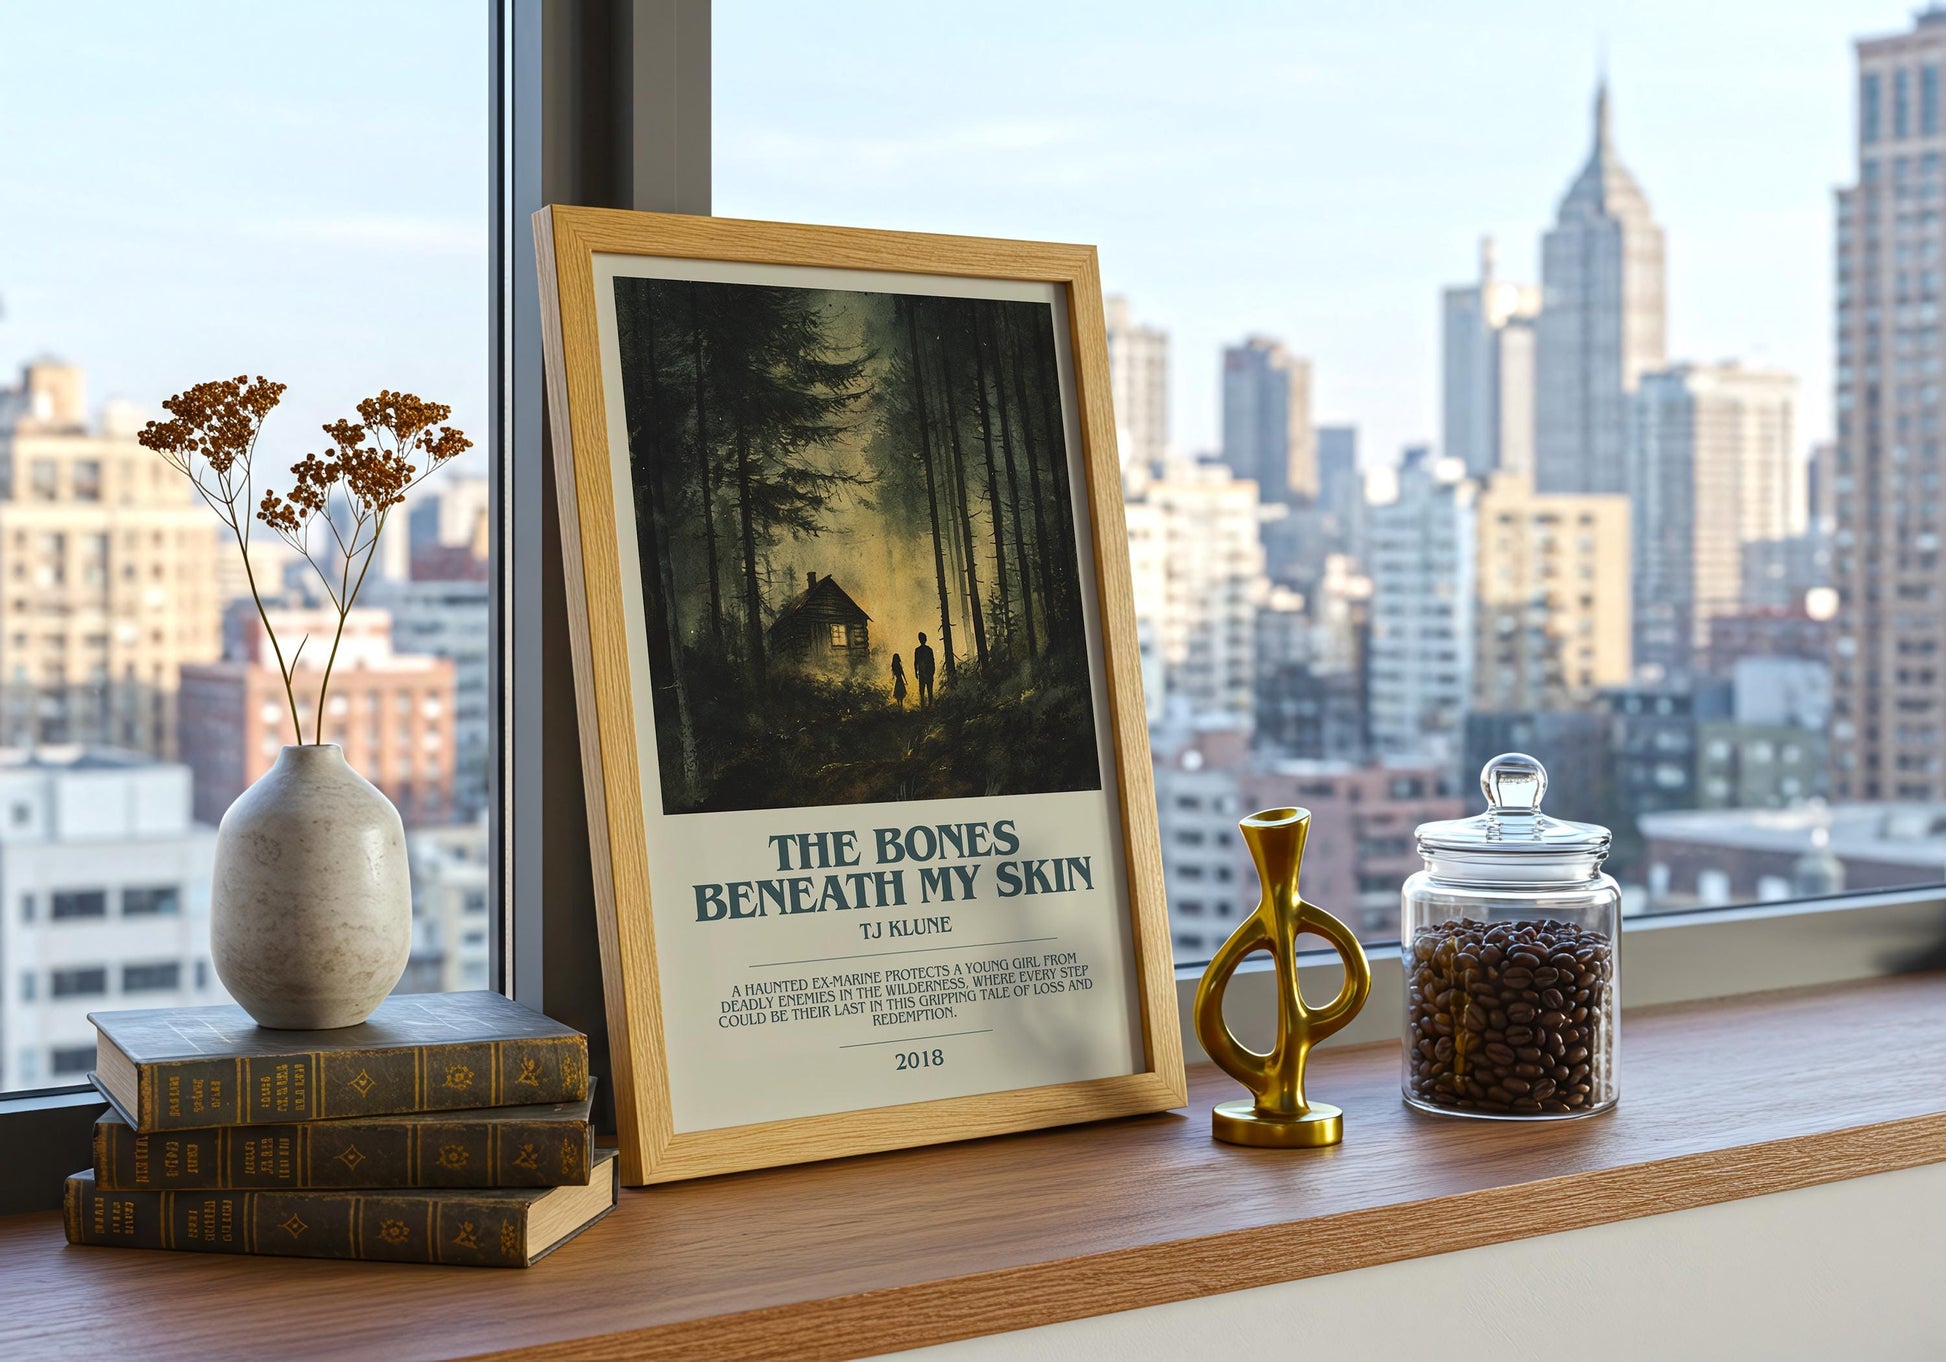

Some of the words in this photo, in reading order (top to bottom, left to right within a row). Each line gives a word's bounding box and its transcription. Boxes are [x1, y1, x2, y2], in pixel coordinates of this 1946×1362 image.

[769, 830, 861, 871] THE
[873, 820, 1019, 864] BONES
[692, 870, 907, 922] BENEATH
[918, 864, 981, 903] MY
[996, 856, 1094, 898] SKIN
[860, 922, 881, 939] TJ
[889, 916, 952, 937] KLUNE
[721, 997, 773, 1013] DEADLY
[778, 990, 835, 1007] ENEMIES
[840, 989, 852, 1001] IN
[856, 986, 882, 999] THE
[886, 977, 968, 996] WILDERNESS,
[973, 972, 1016, 987] WHERE
[1019, 968, 1056, 982] EVERY
[1060, 965, 1088, 978] STEP
[732, 986, 741, 997] A
[745, 979, 808, 996] HAUNTED
[812, 972, 881, 989] EX-MARINE
[886, 965, 950, 982] PROTECTS
[954, 964, 962, 975] A
[965, 959, 1009, 974] YOUNG
[1013, 956, 1040, 969] GIRL
[1044, 953, 1076, 966] FROM
[719, 1012, 766, 1028] COULD
[771, 1010, 788, 1022] BE
[791, 1006, 831, 1020] THEIR
[834, 1002, 866, 1016] LAST
[870, 1000, 882, 1012] IN
[886, 997, 915, 1010] THIS
[919, 990, 976, 1006] GRIPPING
[980, 987, 1010, 1000] TALE
[1014, 985, 1030, 997] OF
[1034, 981, 1065, 995] LOSS
[1069, 978, 1092, 991] AND
[873, 1007, 957, 1026] REDEMPTION.
[895, 1049, 944, 1070] 2018
